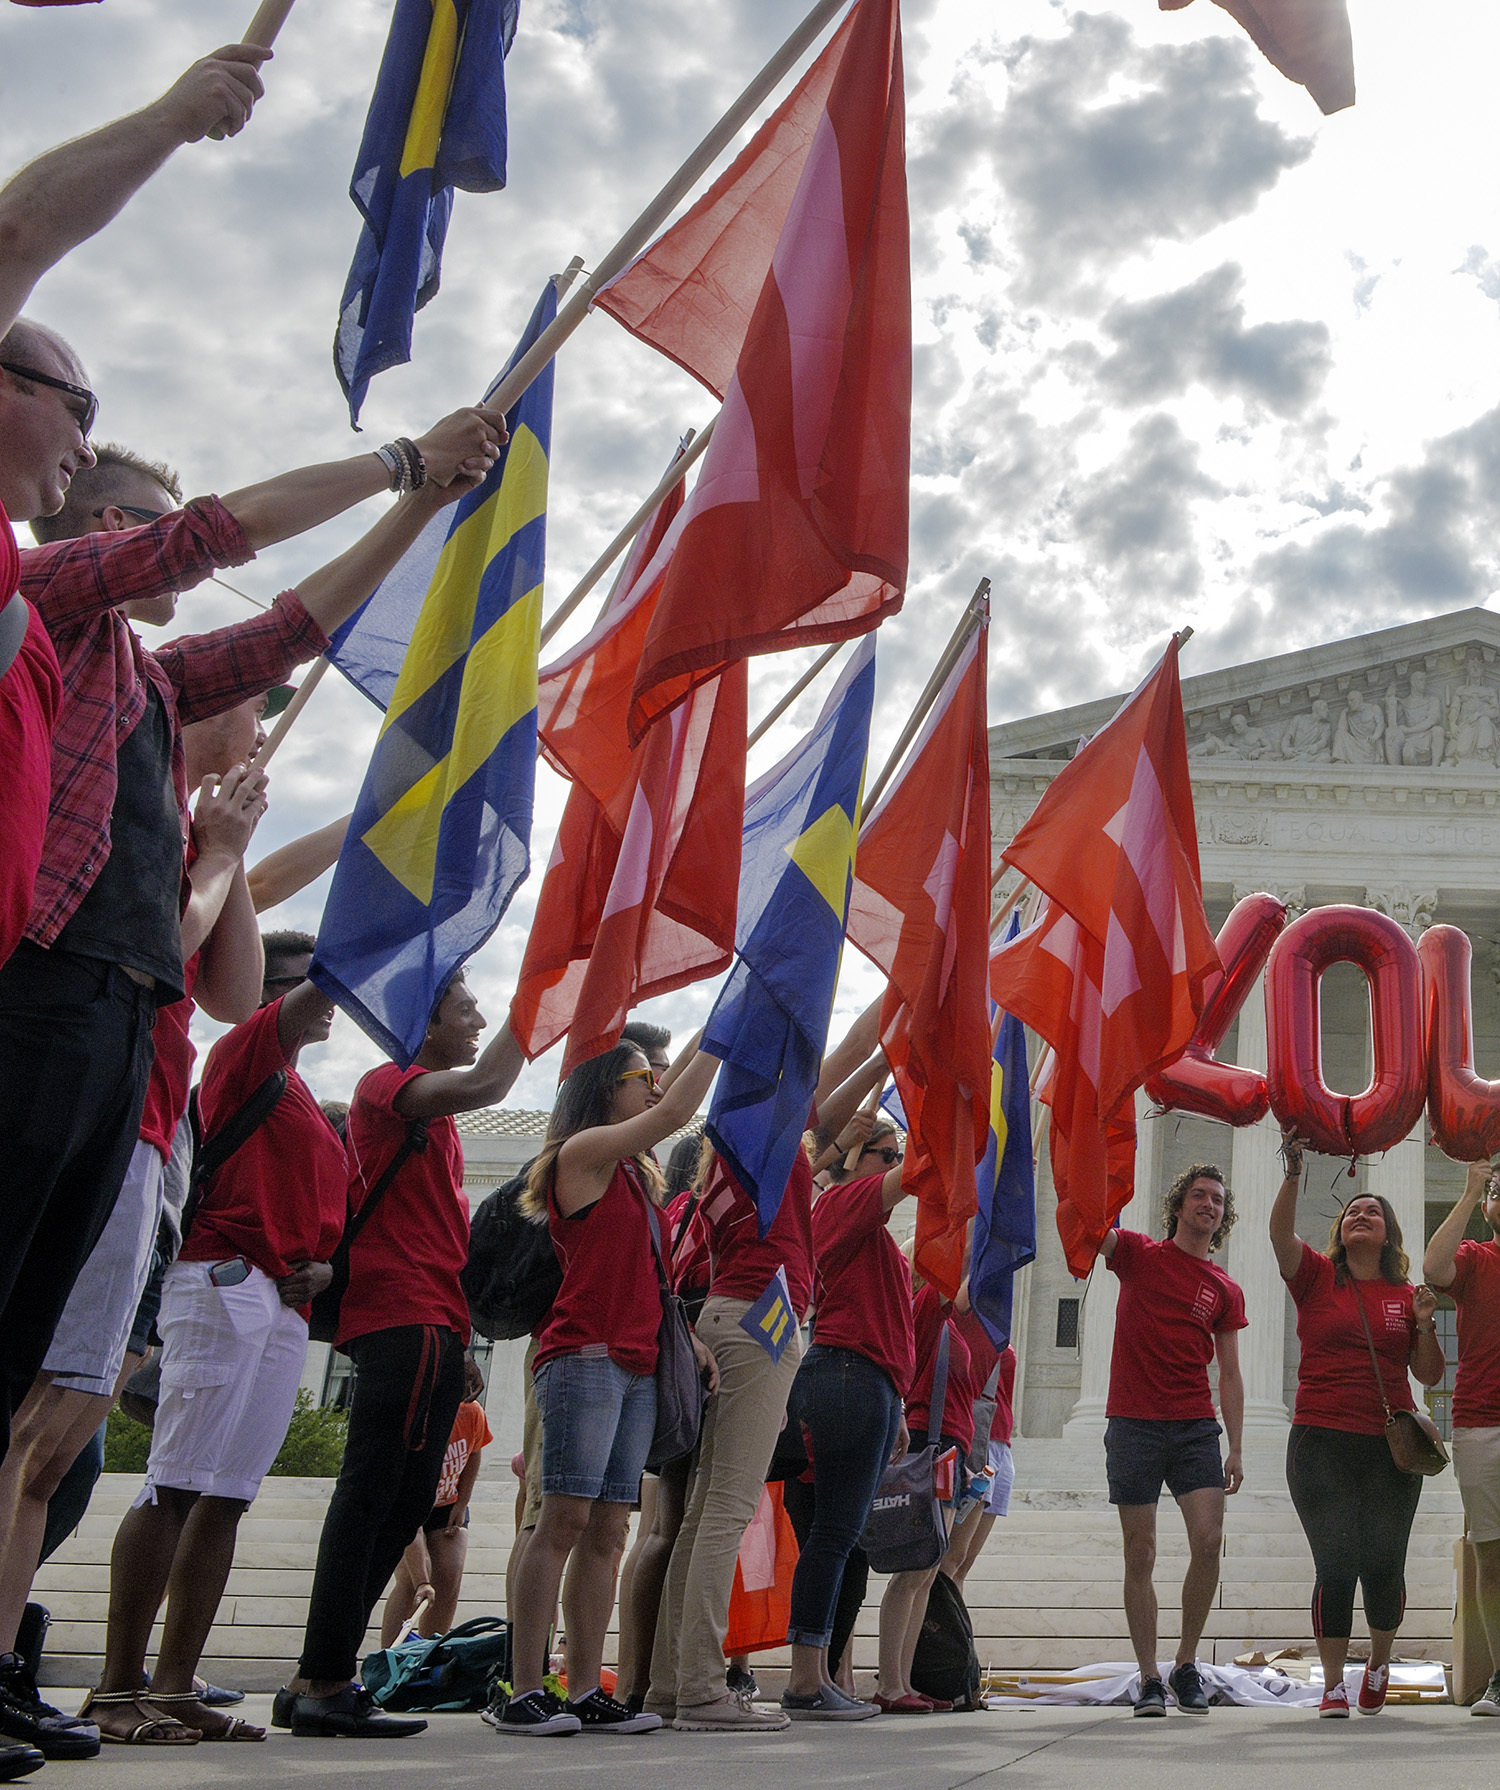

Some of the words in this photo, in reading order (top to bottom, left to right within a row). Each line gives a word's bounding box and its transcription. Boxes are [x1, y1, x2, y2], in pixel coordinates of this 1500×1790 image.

[1290, 821, 1379, 843] EQUAL
[1387, 823, 1492, 846] JUSTICE
[872, 1493, 911, 1511] HATE
